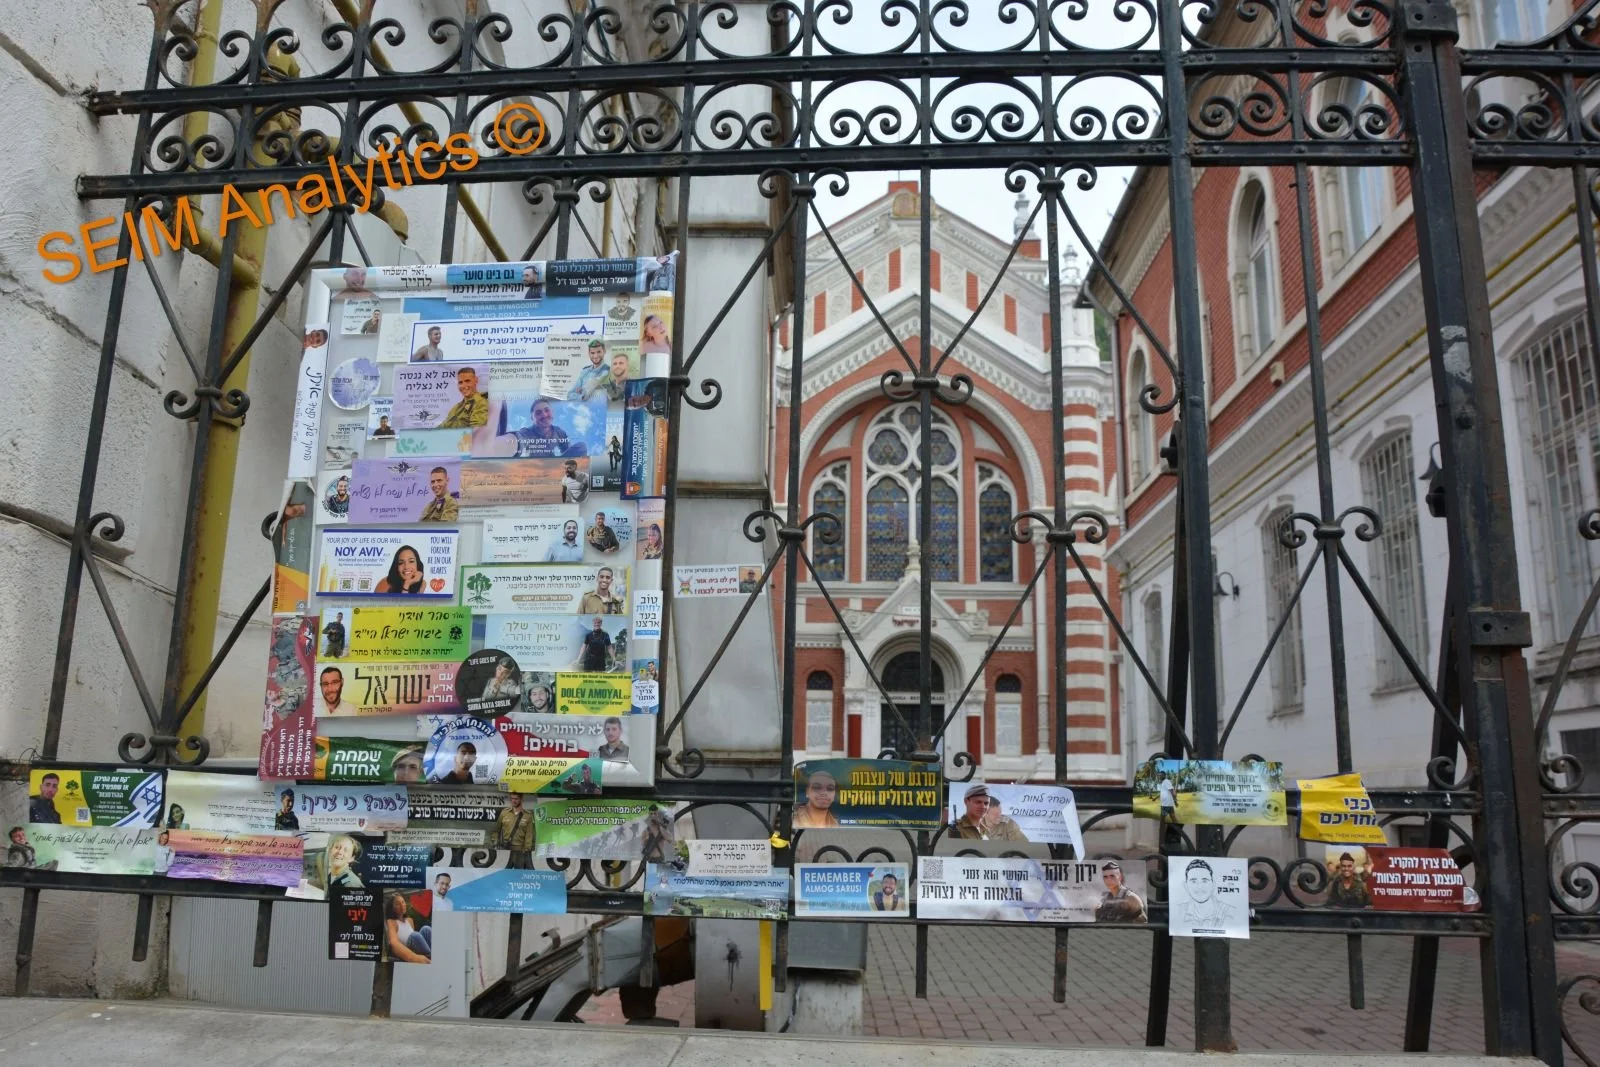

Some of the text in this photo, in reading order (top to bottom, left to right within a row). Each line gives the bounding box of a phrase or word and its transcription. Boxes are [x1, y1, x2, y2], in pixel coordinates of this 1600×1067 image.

[463, 269, 514, 281] גם בים סוער
[400, 276, 432, 288] לחייך
[498, 302, 539, 311] SYNAGOGUE
[463, 328, 488, 337] חזקים
[490, 326, 515, 334] להיות
[510, 348, 527, 357] אסף
[551, 358, 570, 367] הנני
[400, 370, 456, 380] אם לא ננסה
[306, 366, 322, 399] איתי
[406, 380, 449, 391] לא נצליח
[305, 402, 317, 418] תמיד
[304, 422, 317, 437] שלך
[341, 537, 350, 545] JOY
[335, 547, 384, 557] NOY AVIV
[430, 546, 450, 555] FOREVER
[640, 596, 658, 605] טוב
[635, 604, 661, 612] לחיות
[636, 620, 660, 628] ארצנו
[381, 625, 410, 640] ישראל
[414, 629, 443, 639] גיבור
[439, 673, 454, 681] עם
[355, 668, 431, 705] ישראל
[433, 684, 454, 694] ארץ
[428, 695, 453, 703] תורת
[500, 721, 604, 735] לא לוותר על החיים
[524, 735, 579, 753] בחיים!
[335, 750, 382, 762] שמחה
[331, 764, 381, 777] אחדות
[852, 771, 936, 787] מרגע של עצבות
[840, 789, 936, 807] נצא גדולים וחזקים
[302, 793, 408, 816] למה? כי צריך!
[415, 807, 496, 821] או לעשות משהו טוב
[575, 817, 584, 825] לא
[724, 852, 746, 861] תסלול
[804, 872, 862, 883] REMEMBER
[962, 869, 1029, 882] הקושי הוא זמני
[1041, 863, 1097, 884] ירון זוהר
[1403, 872, 1431, 885] בשביל
[736, 879, 752, 887] להיות
[1432, 874, 1464, 886] מעצמך
[805, 885, 862, 893] ALMOG SARUSI
[922, 884, 1023, 902] הגאווה היא נצחית
[1217, 887, 1240, 895] ראבק
[348, 908, 369, 921] ליבי
